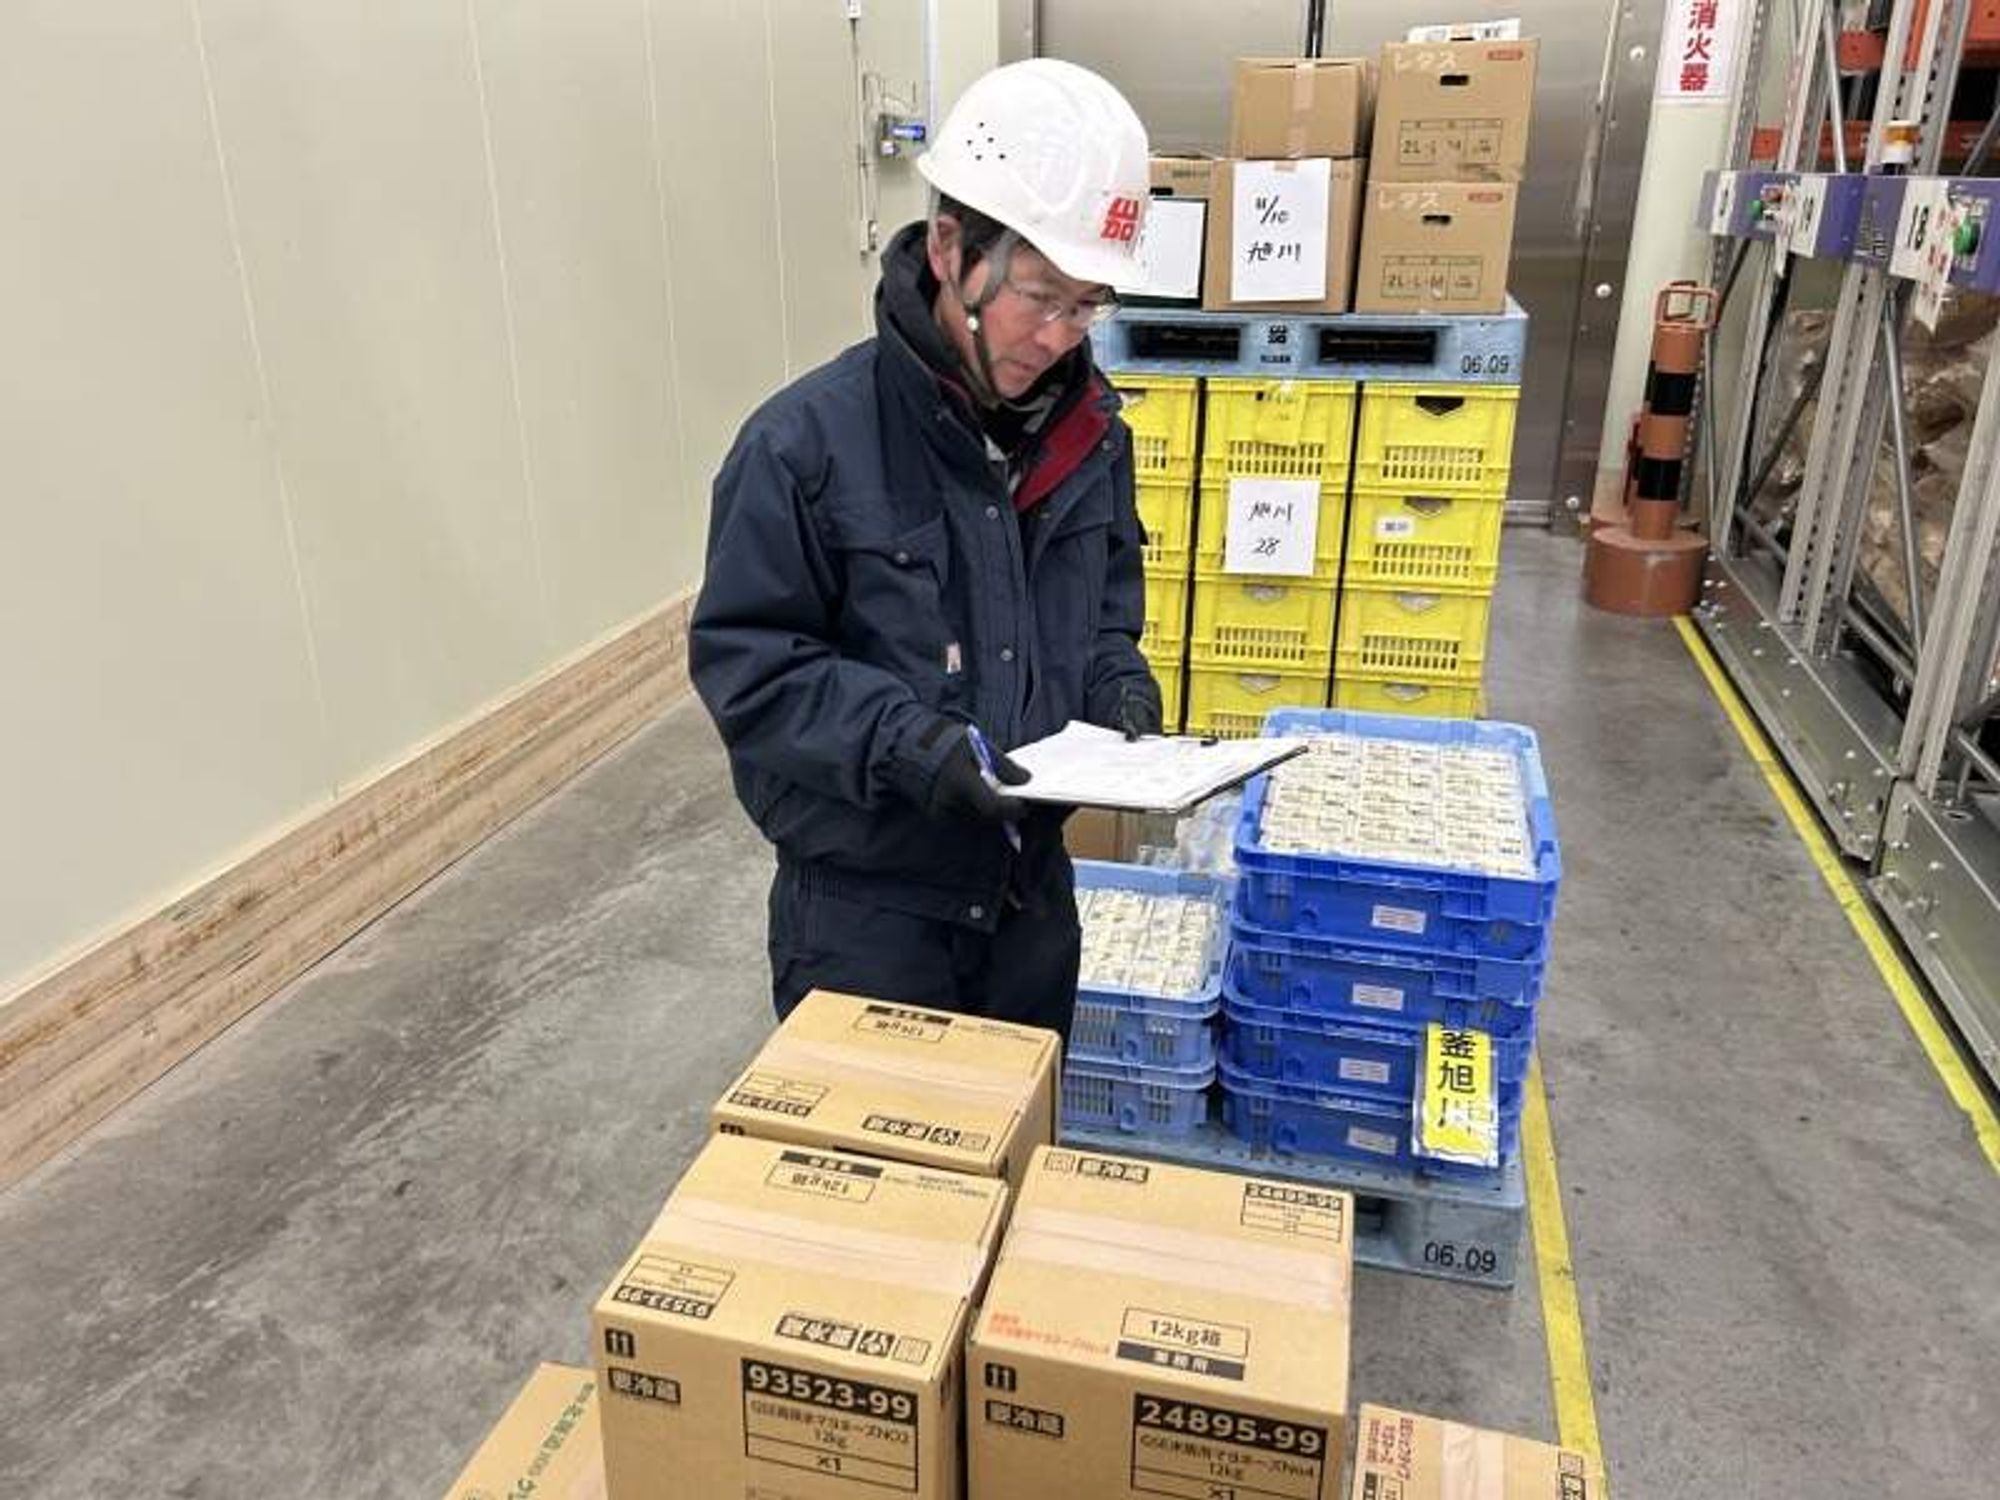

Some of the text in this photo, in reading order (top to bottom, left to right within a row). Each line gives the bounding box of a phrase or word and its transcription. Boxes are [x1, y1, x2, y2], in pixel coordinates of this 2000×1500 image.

[1680, 0, 1718, 91] 消火器
[1247, 241, 1301, 264] 旭川
[1461, 354, 1509, 375] 06.09
[1252, 537, 1281, 557] 28
[1424, 1242, 1497, 1273] 06.09
[748, 1364, 913, 1419] 93523-99
[1139, 1400, 1321, 1454] 24895-99
